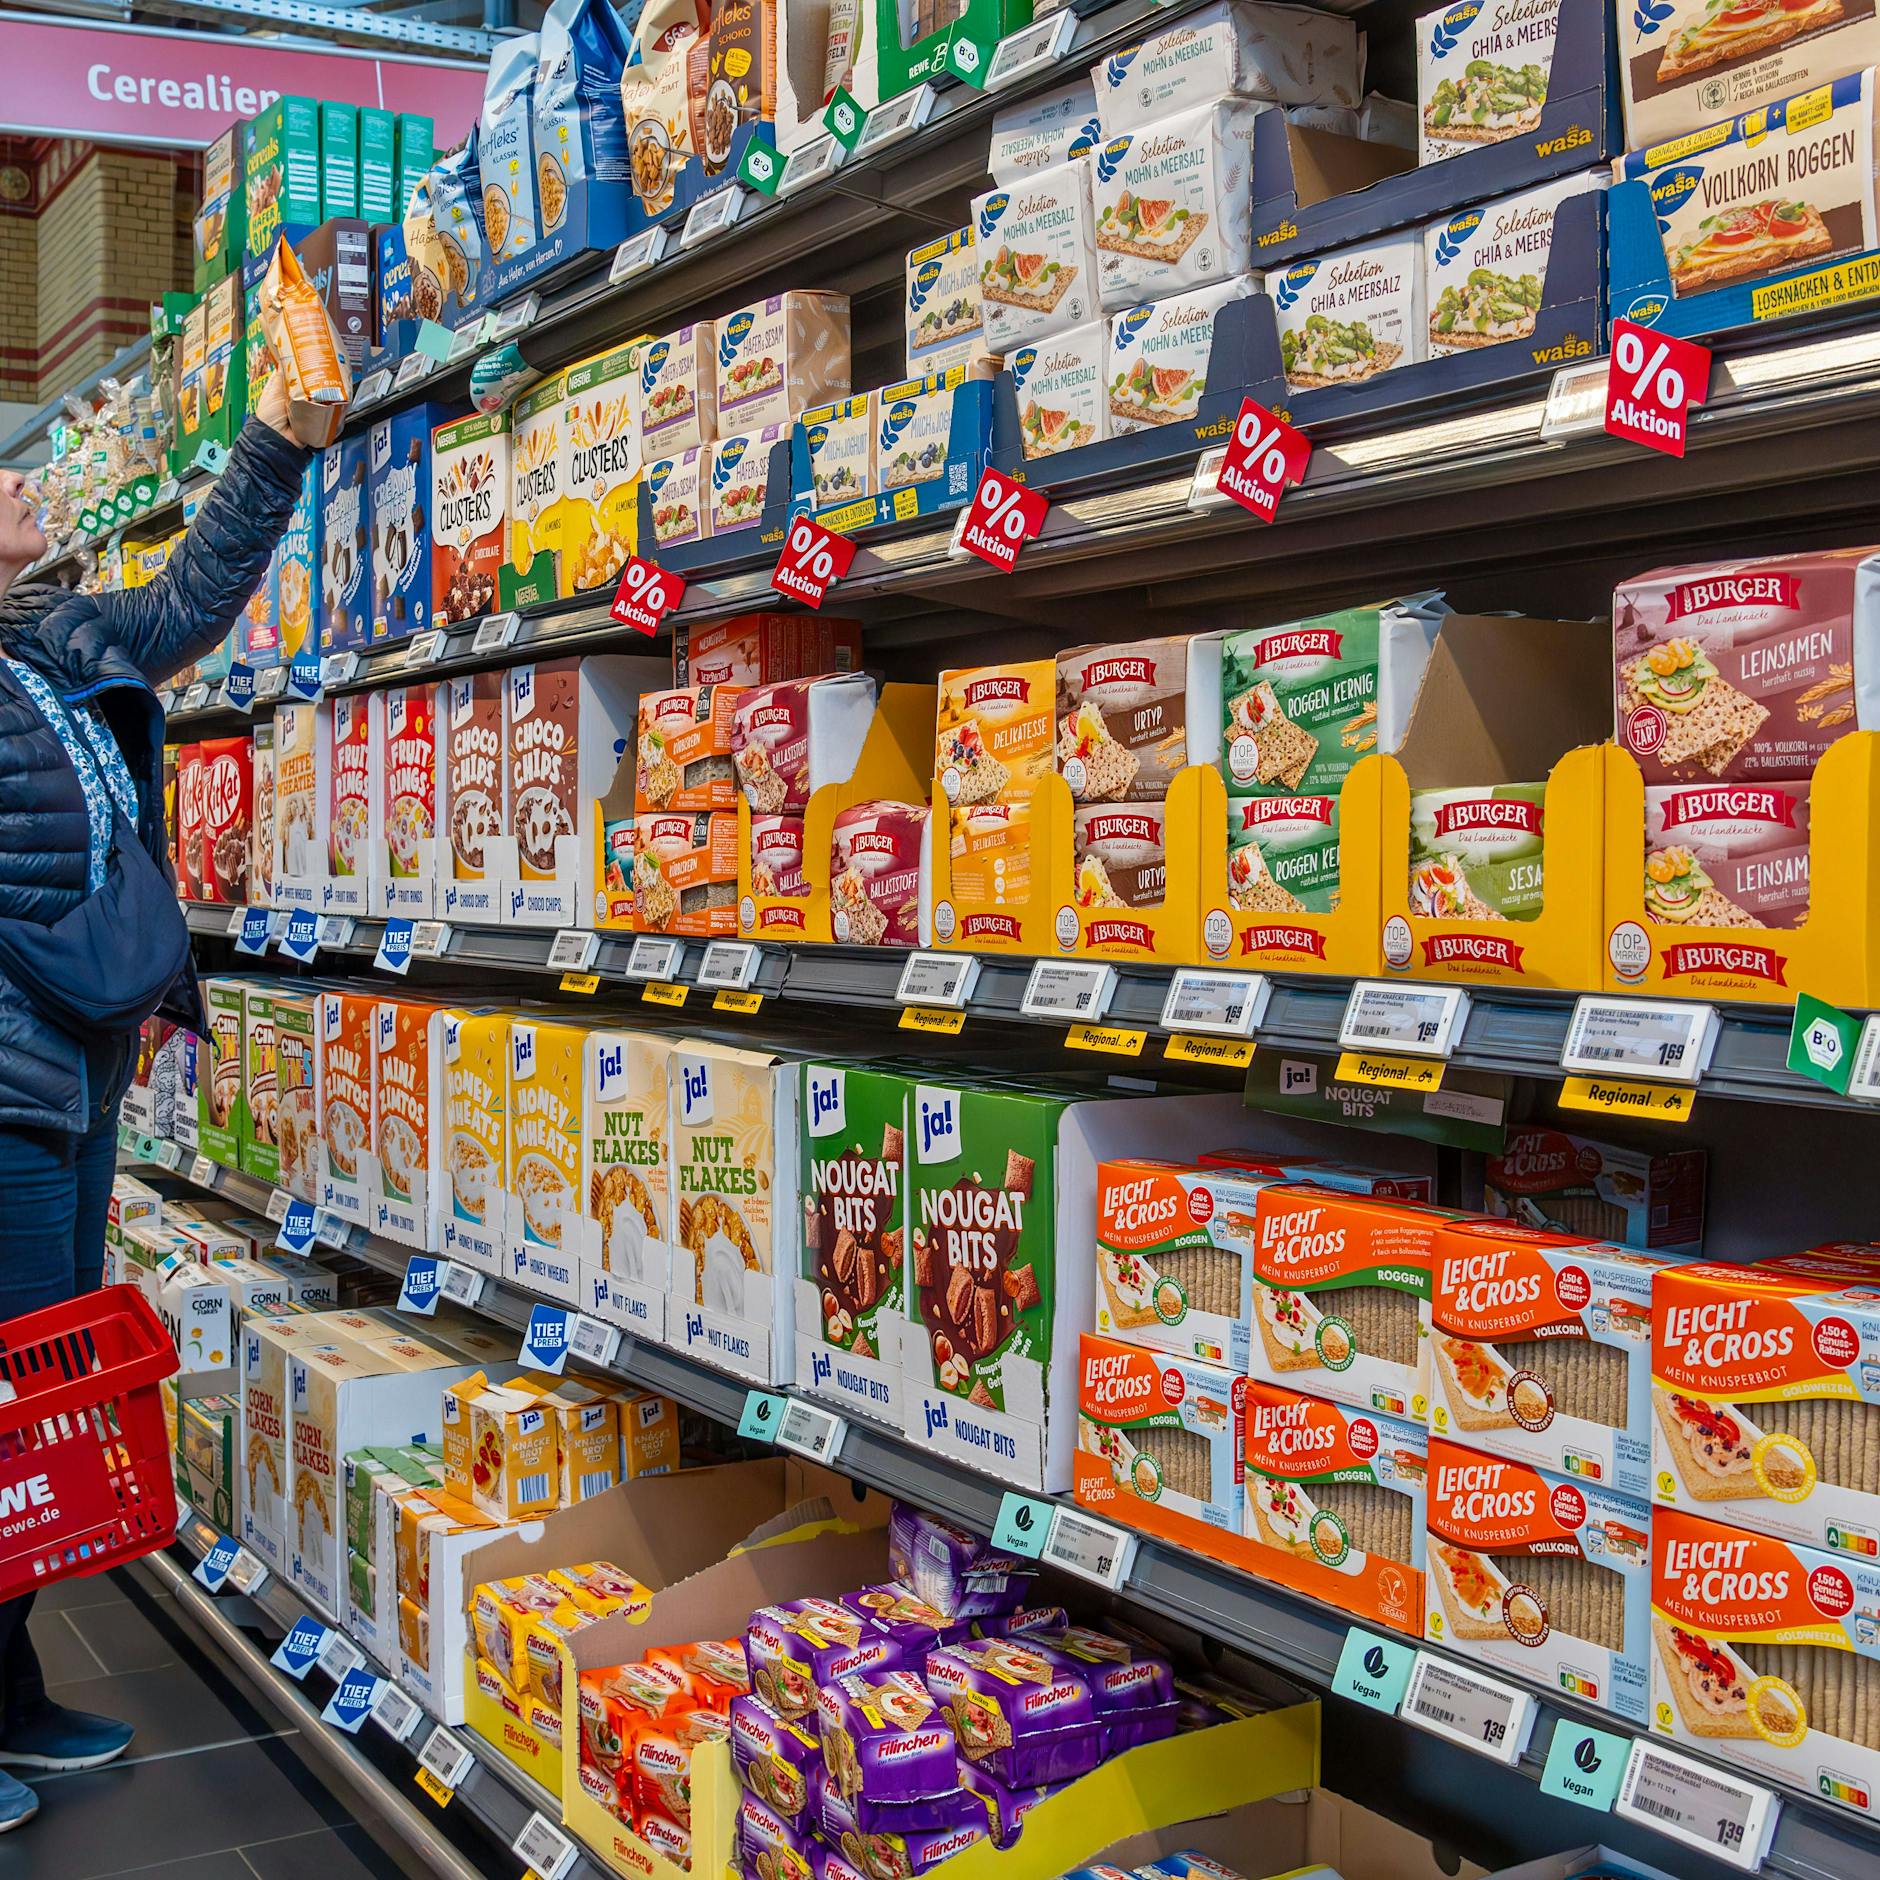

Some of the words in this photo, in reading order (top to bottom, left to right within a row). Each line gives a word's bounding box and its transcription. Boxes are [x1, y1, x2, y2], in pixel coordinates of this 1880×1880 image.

[718, 27, 751, 46] SCHOKO
[1156, 30, 1196, 55] Selection
[908, 58, 929, 79] REWE
[1143, 60, 1168, 77] MOHN
[1175, 38, 1213, 63] MEERSALZ
[87, 64, 280, 115] Cerealien
[660, 81, 678, 95] ZIMT
[492, 150, 518, 164] KLASSIK
[1140, 135, 1186, 164] Selection
[1125, 166, 1152, 187] MOHN
[1161, 148, 1205, 175] MEERSALZ
[1702, 153, 1779, 208] VOLLKORN
[1787, 130, 1855, 183] ROGGEN
[1328, 260, 1384, 290] Selection
[1311, 292, 1336, 313] CHIA
[1348, 275, 1400, 304] MEERSALZ
[1757, 278, 1829, 311] LOSKNÄCKEN
[1833, 274, 1844, 290] &
[765, 326, 784, 347] SESAM
[1616, 332, 1684, 409] %
[1611, 398, 1680, 440] Aktion
[374, 426, 388, 464] ja!
[1237, 412, 1287, 484] %
[1222, 464, 1275, 510] Aktion
[981, 478, 1026, 539] %
[475, 544, 500, 559] CHOCOLATE
[791, 526, 833, 579] %
[966, 524, 1015, 562] Aktion
[777, 566, 822, 599] Aktion
[1691, 577, 1782, 608] BURGER
[1696, 615, 1713, 626] Das
[1270, 633, 1330, 658] BURGER
[1740, 629, 1833, 680] LEINSAMEN
[294, 666, 318, 677] TIEF
[1096, 661, 1146, 683] BURGER
[1761, 672, 1792, 688] herzhaft
[1793, 667, 1816, 680] nussig
[514, 672, 530, 714] ja!
[976, 681, 1021, 700] BURGER
[1288, 690, 1330, 719] ROGGEN
[1333, 673, 1373, 703] KERNIG
[1134, 706, 1163, 732] URTYP
[515, 718, 564, 752] CHOCO
[993, 717, 1048, 750] DELIKATESSE
[1634, 724, 1657, 747] ZART
[280, 752, 311, 777] WHITE
[391, 739, 432, 770] FRUIT
[514, 748, 562, 789] CHIPS
[1761, 755, 1809, 767] BALLASTSTOFFE
[277, 772, 315, 800] WHEATIES
[390, 767, 428, 799] RINGS
[1455, 804, 1529, 828] BURGER
[870, 872, 918, 899] BALLASTSTOFF
[290, 934, 312, 942] PREIS
[291, 922, 314, 934] TIEF
[1615, 933, 1642, 949] TOP
[1615, 951, 1644, 961] MARKE
[1687, 946, 1769, 976] BURGER
[383, 1055, 416, 1091] MINI
[1358, 1061, 1408, 1080] Regional
[684, 1065, 708, 1114] ja!
[1325, 1086, 1392, 1104] NOUGAT
[1588, 1084, 1652, 1106] Regional
[379, 1085, 424, 1127] ZIMTOS
[518, 1086, 569, 1129] HONEY
[1342, 1102, 1374, 1118] BITS
[922, 1100, 953, 1152] ja!
[515, 1118, 577, 1169] WHEATS
[692, 1136, 733, 1164] NUT
[680, 1166, 757, 1195] FLAKES
[920, 1188, 1025, 1232] NOUGAT
[1261, 1208, 1322, 1249] LEICHT
[947, 1230, 998, 1271] BITS
[1273, 1228, 1346, 1264] &CROSS
[1261, 1264, 1281, 1279] MEIN
[1283, 1260, 1341, 1280] KNUSPERBROT
[1377, 1270, 1424, 1288] ROGGEN
[192, 1298, 223, 1311] CORN
[534, 1323, 563, 1337] TIEF
[1533, 1326, 1584, 1339] VOLLKORN
[1664, 1300, 1753, 1348] LEICHT
[537, 1338, 560, 1347] PREIS
[1683, 1326, 1794, 1368] &CROSS
[1783, 1384, 1852, 1398] GOLDWEIZEN
[295, 1421, 322, 1449] CORN
[512, 1436, 551, 1451] KNÄCKE
[955, 1419, 990, 1449] NOUGAT
[994, 1435, 1016, 1460] BITS
[519, 1447, 544, 1458] BROT
[1379, 1605, 1406, 1621] VEGAN
[1025, 1684, 1075, 1712] Filinchen
[1353, 1679, 1381, 1701] Vegan
[640, 1743, 681, 1768] Filinchen
[877, 1732, 940, 1758] Filinchen
[1562, 1777, 1594, 1797] Vegan
